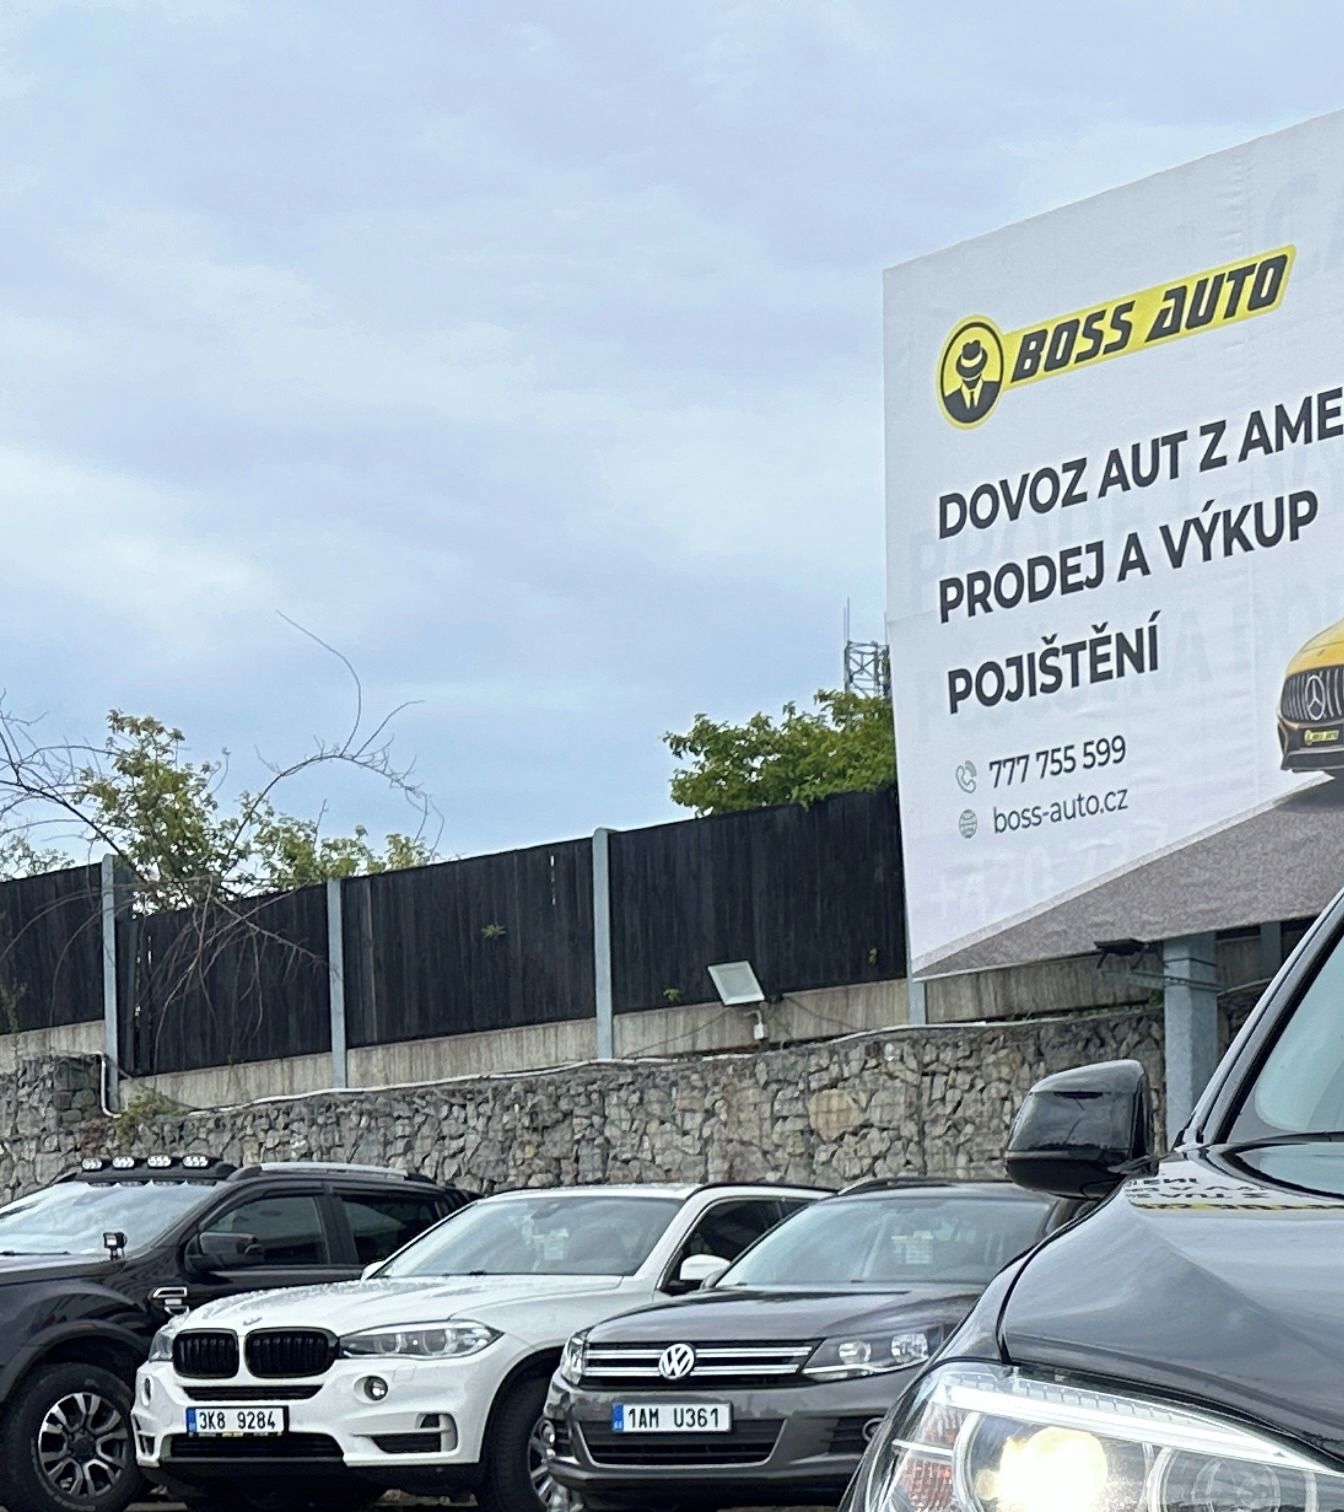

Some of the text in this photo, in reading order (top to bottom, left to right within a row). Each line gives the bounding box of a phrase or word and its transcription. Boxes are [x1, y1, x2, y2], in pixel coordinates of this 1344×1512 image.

[1010, 254, 1288, 384] BOSS AUTO
[939, 457, 1088, 539] DOVOZ
[1097, 430, 1188, 498] AUT
[1199, 420, 1227, 472] Z
[939, 490, 1318, 624] PRODEJ A VÝKUP
[947, 610, 1161, 714] POJIŠTĚNÍ
[989, 735, 1127, 788] 777 755 599
[993, 788, 1129, 834] boss-auto.cz
[199, 1411, 226, 1429] 3K8
[236, 1411, 276, 1429] 9284
[628, 1407, 659, 1428] 1AM
[673, 1407, 719, 1428] U361
